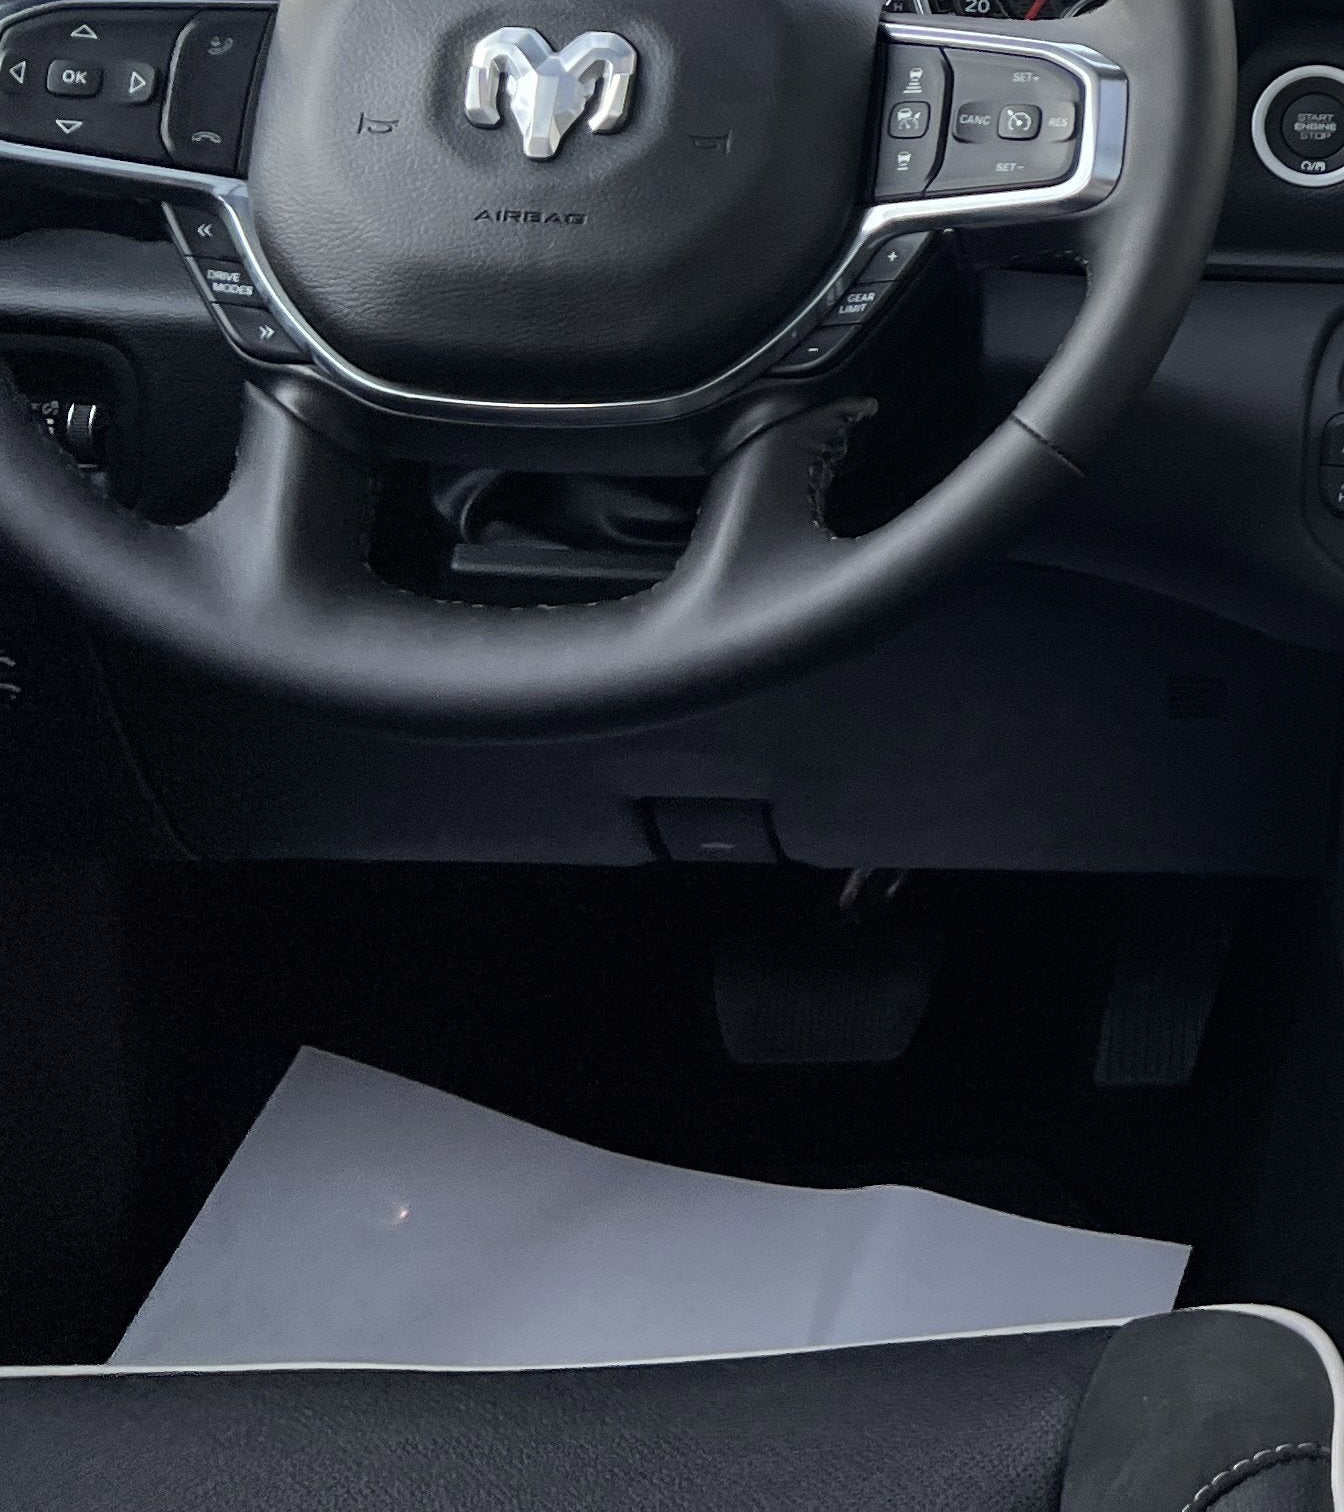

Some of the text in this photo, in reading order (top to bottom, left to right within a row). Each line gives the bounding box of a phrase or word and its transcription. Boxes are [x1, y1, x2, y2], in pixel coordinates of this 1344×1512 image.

[62, 69, 88, 86] OK
[960, 114, 991, 126] CANC
[1048, 117, 1068, 127] RES
[1297, 113, 1334, 122] START
[1294, 122, 1337, 131] ENGINE
[1300, 131, 1331, 140] STOP
[474, 209, 588, 225] AIRBAG
[847, 292, 876, 303] GEAR
[839, 303, 868, 314] LIMIT
